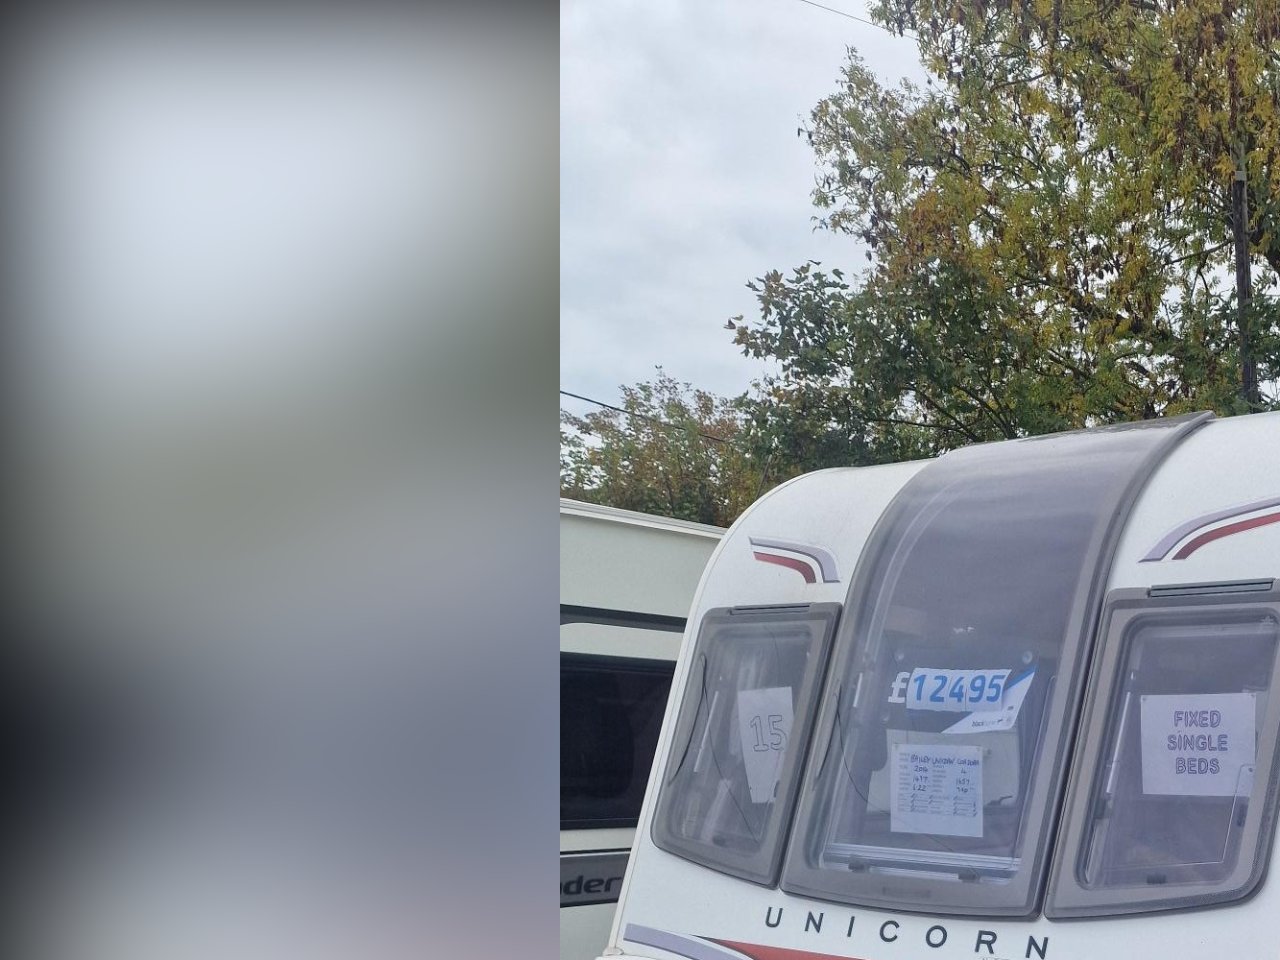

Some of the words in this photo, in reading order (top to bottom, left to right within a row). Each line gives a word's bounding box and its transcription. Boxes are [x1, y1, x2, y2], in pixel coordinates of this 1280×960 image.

[888, 672, 1006, 703] £12495
[1174, 710, 1222, 728] FIXED
[750, 714, 788, 752] 15
[1167, 733, 1229, 751] SINGLE
[1175, 757, 1220, 774] BEDS
[560, 874, 624, 896] der
[765, 906, 1049, 960] UNICORN
